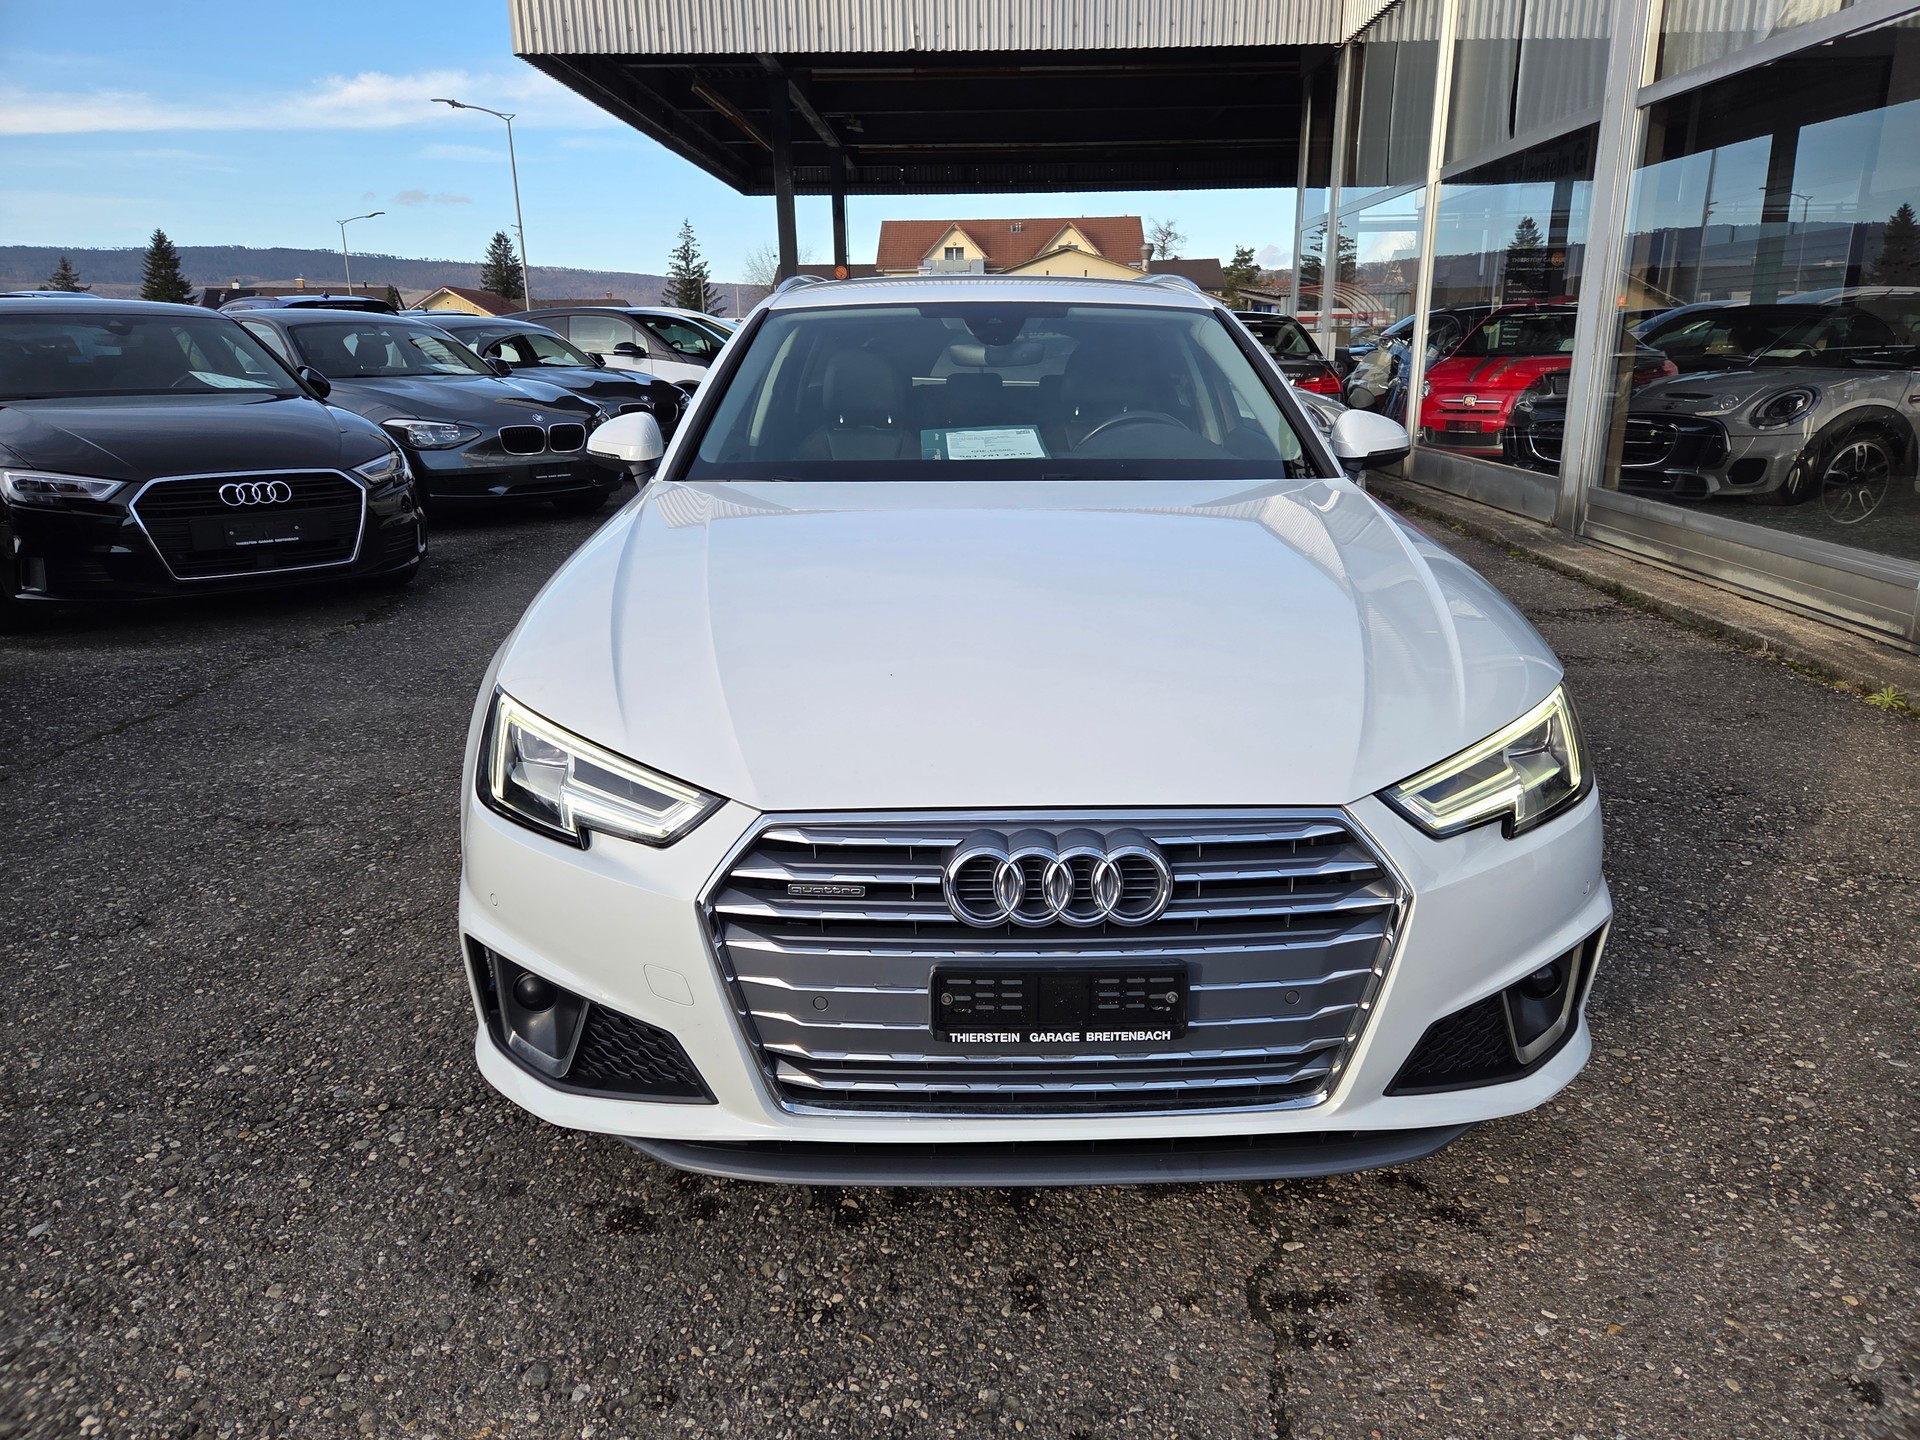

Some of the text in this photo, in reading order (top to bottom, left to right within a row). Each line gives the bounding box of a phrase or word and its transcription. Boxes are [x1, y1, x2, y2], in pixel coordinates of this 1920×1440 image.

[790, 886, 862, 895] quattro
[949, 1030, 1171, 1043] THIERSTEIN GARAGE BREITENBACH
